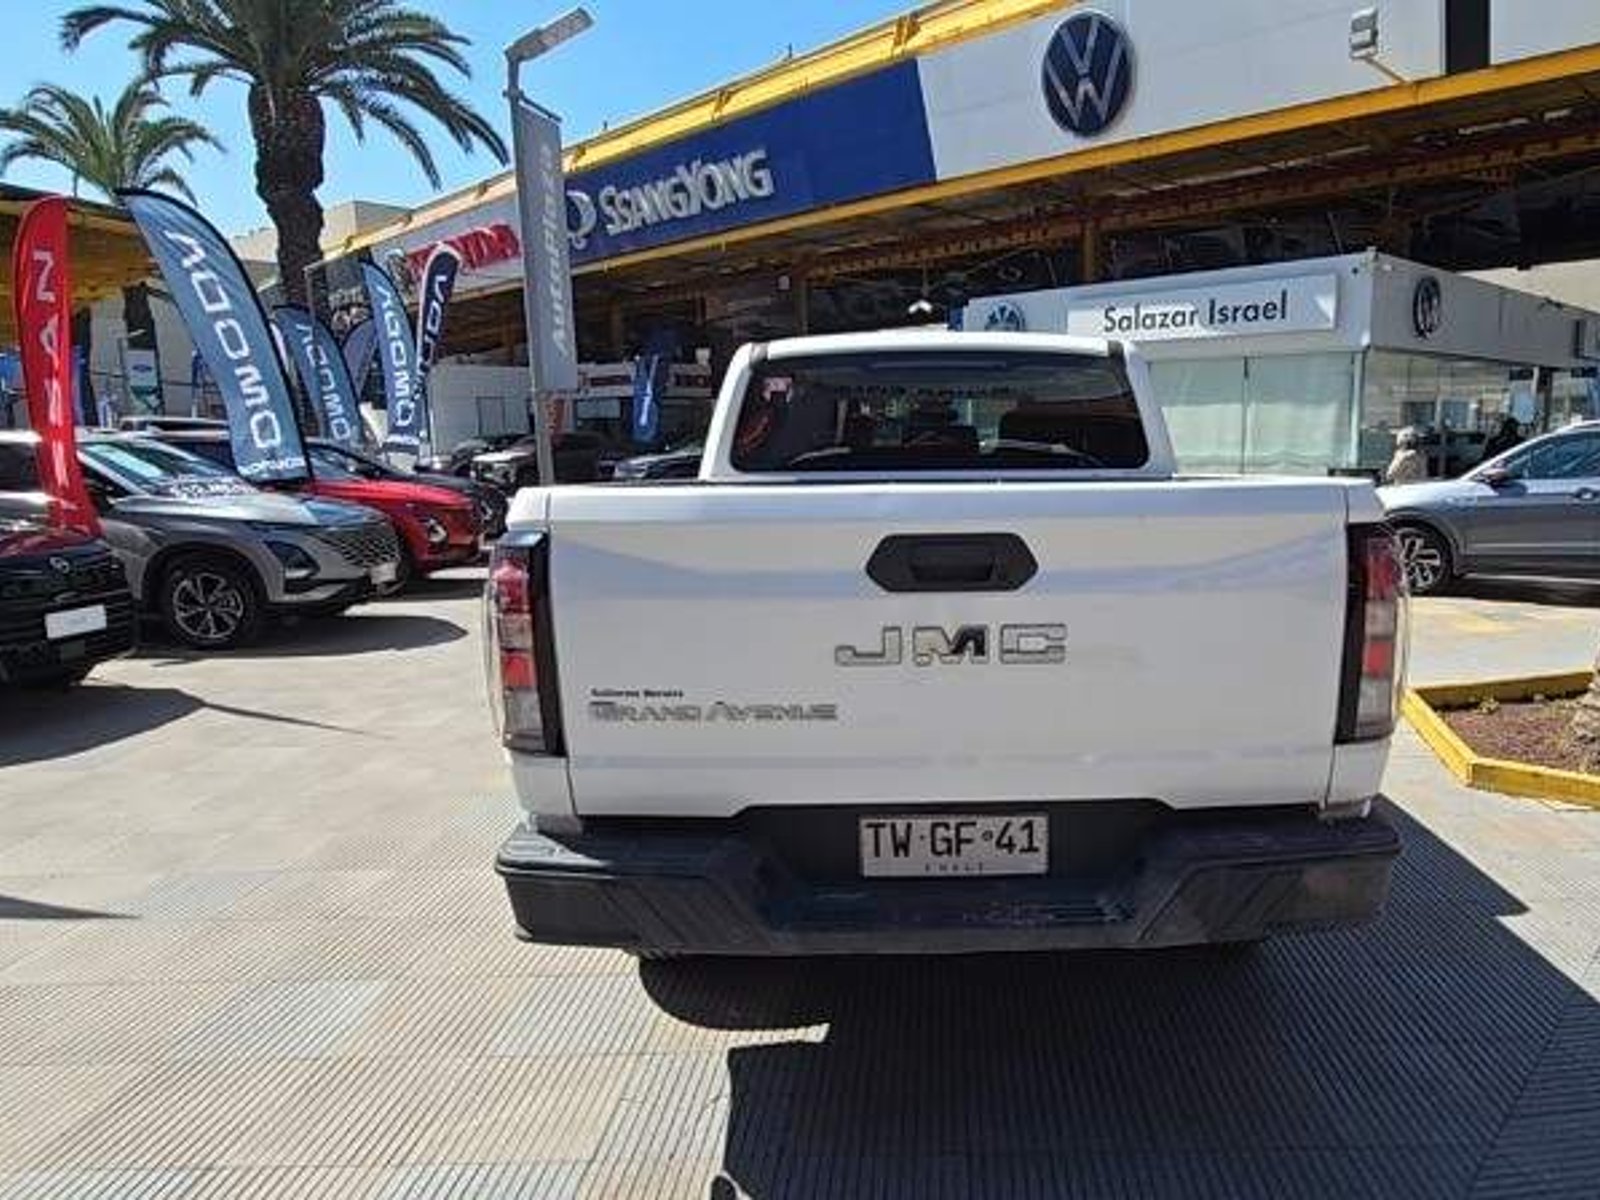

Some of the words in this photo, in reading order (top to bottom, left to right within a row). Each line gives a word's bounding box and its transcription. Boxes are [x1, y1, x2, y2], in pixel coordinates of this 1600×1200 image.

[1103, 305, 1198, 333] Salazar
[1208, 289, 1288, 325] Israel
[834, 623, 1067, 666] JMC
